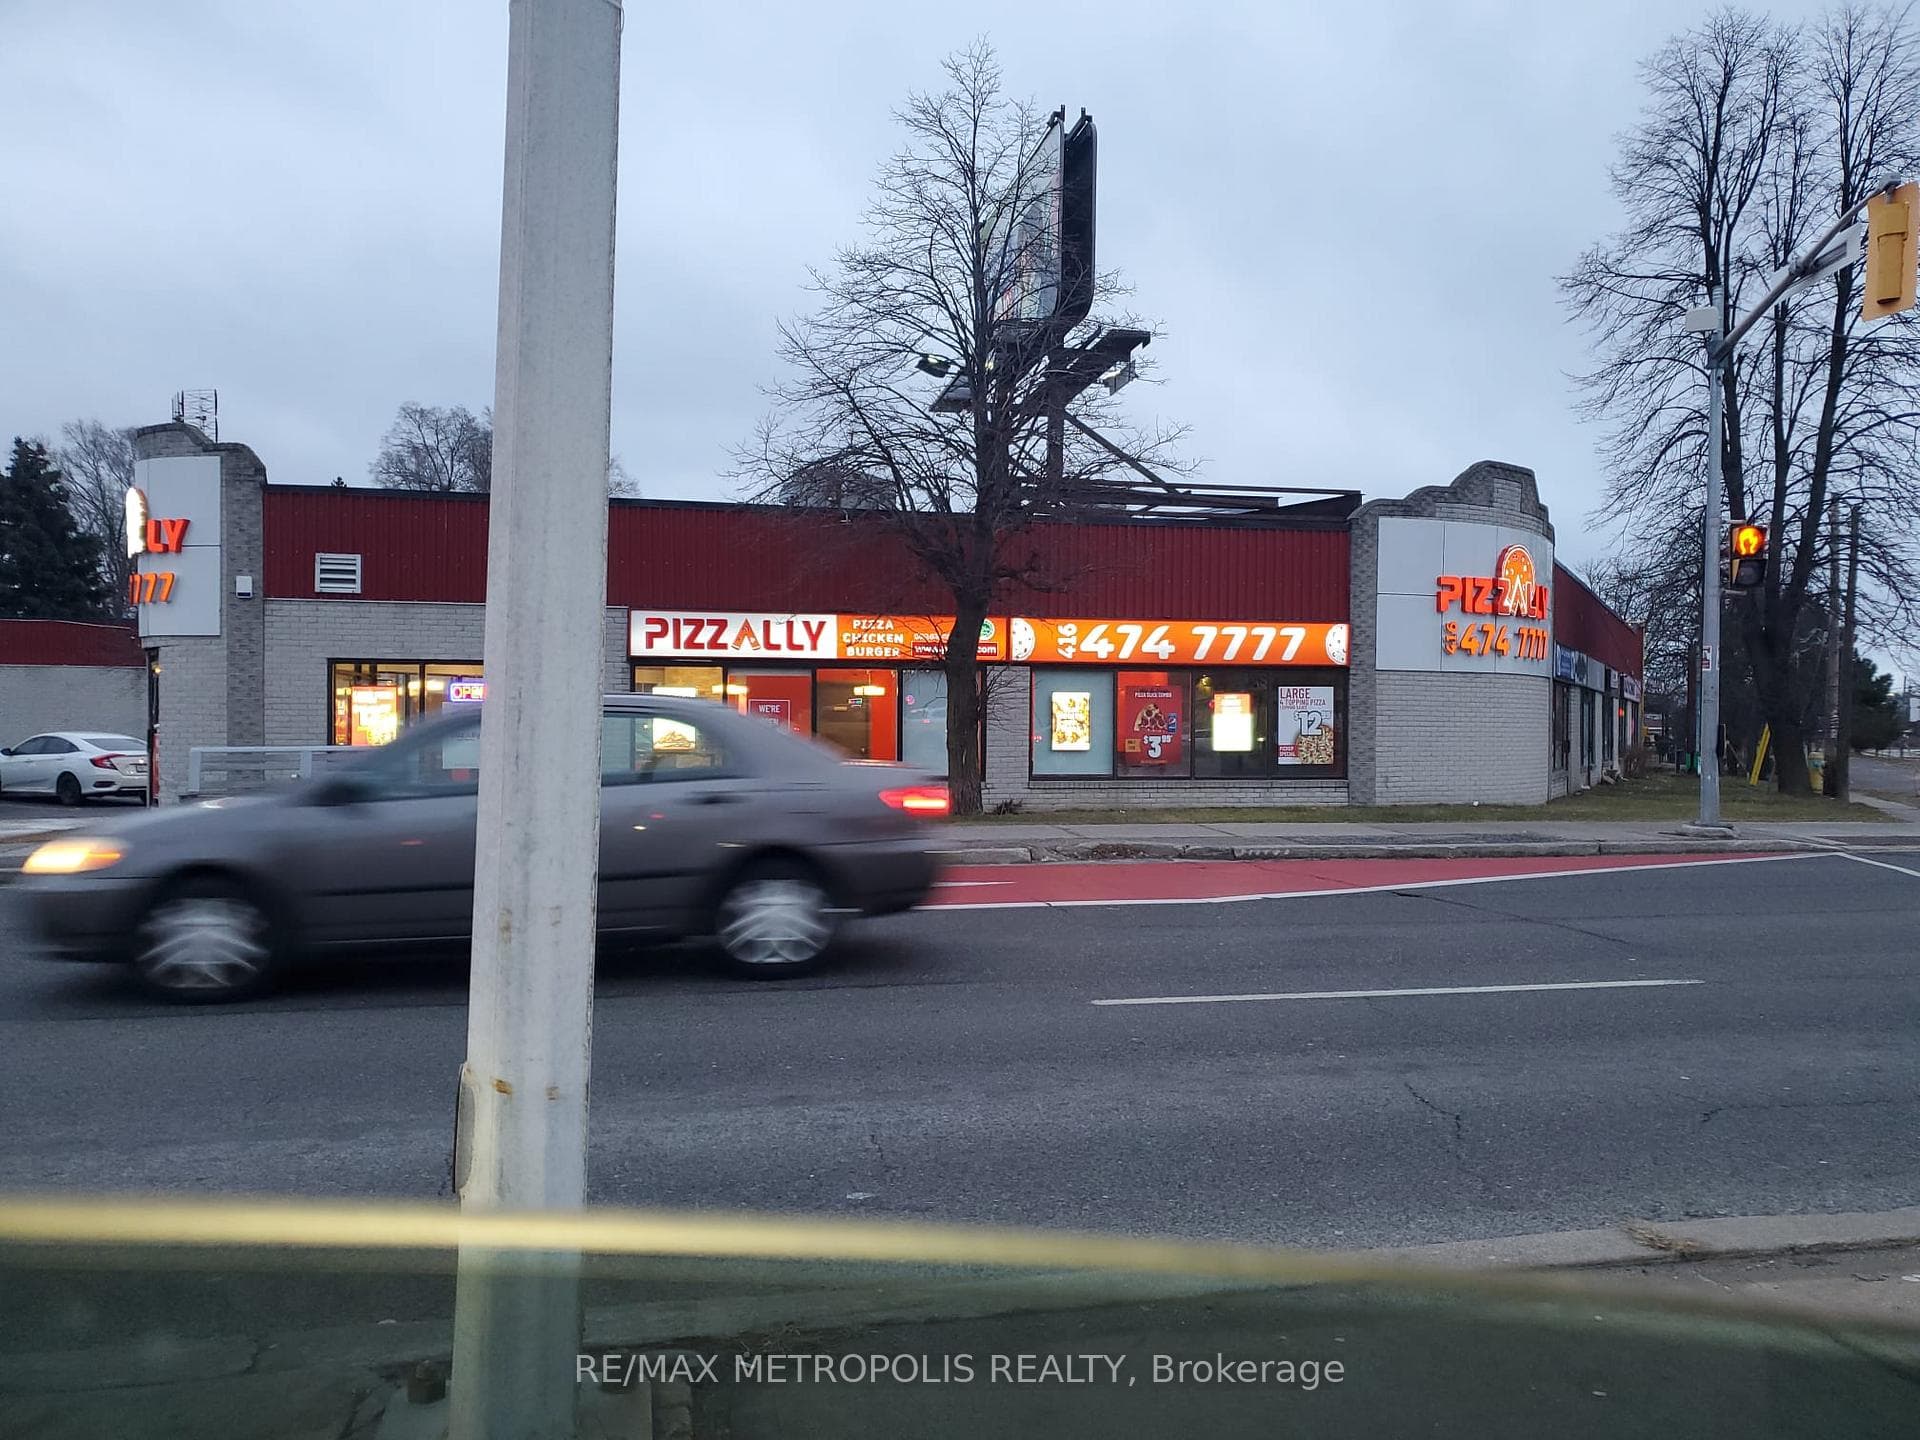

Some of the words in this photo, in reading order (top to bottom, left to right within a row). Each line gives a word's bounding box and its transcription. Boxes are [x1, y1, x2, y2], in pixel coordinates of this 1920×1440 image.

[852, 619, 894, 630] PIZZA
[645, 617, 827, 652] PIZZALLY
[842, 632, 904, 644] CHICKEN
[1460, 622, 1511, 657] 474
[1057, 622, 1078, 659] 416
[1079, 624, 1175, 660] 474
[1192, 625, 1306, 661] 7777
[846, 646, 900, 657] BURGER
[1279, 688, 1311, 699] LARGE
